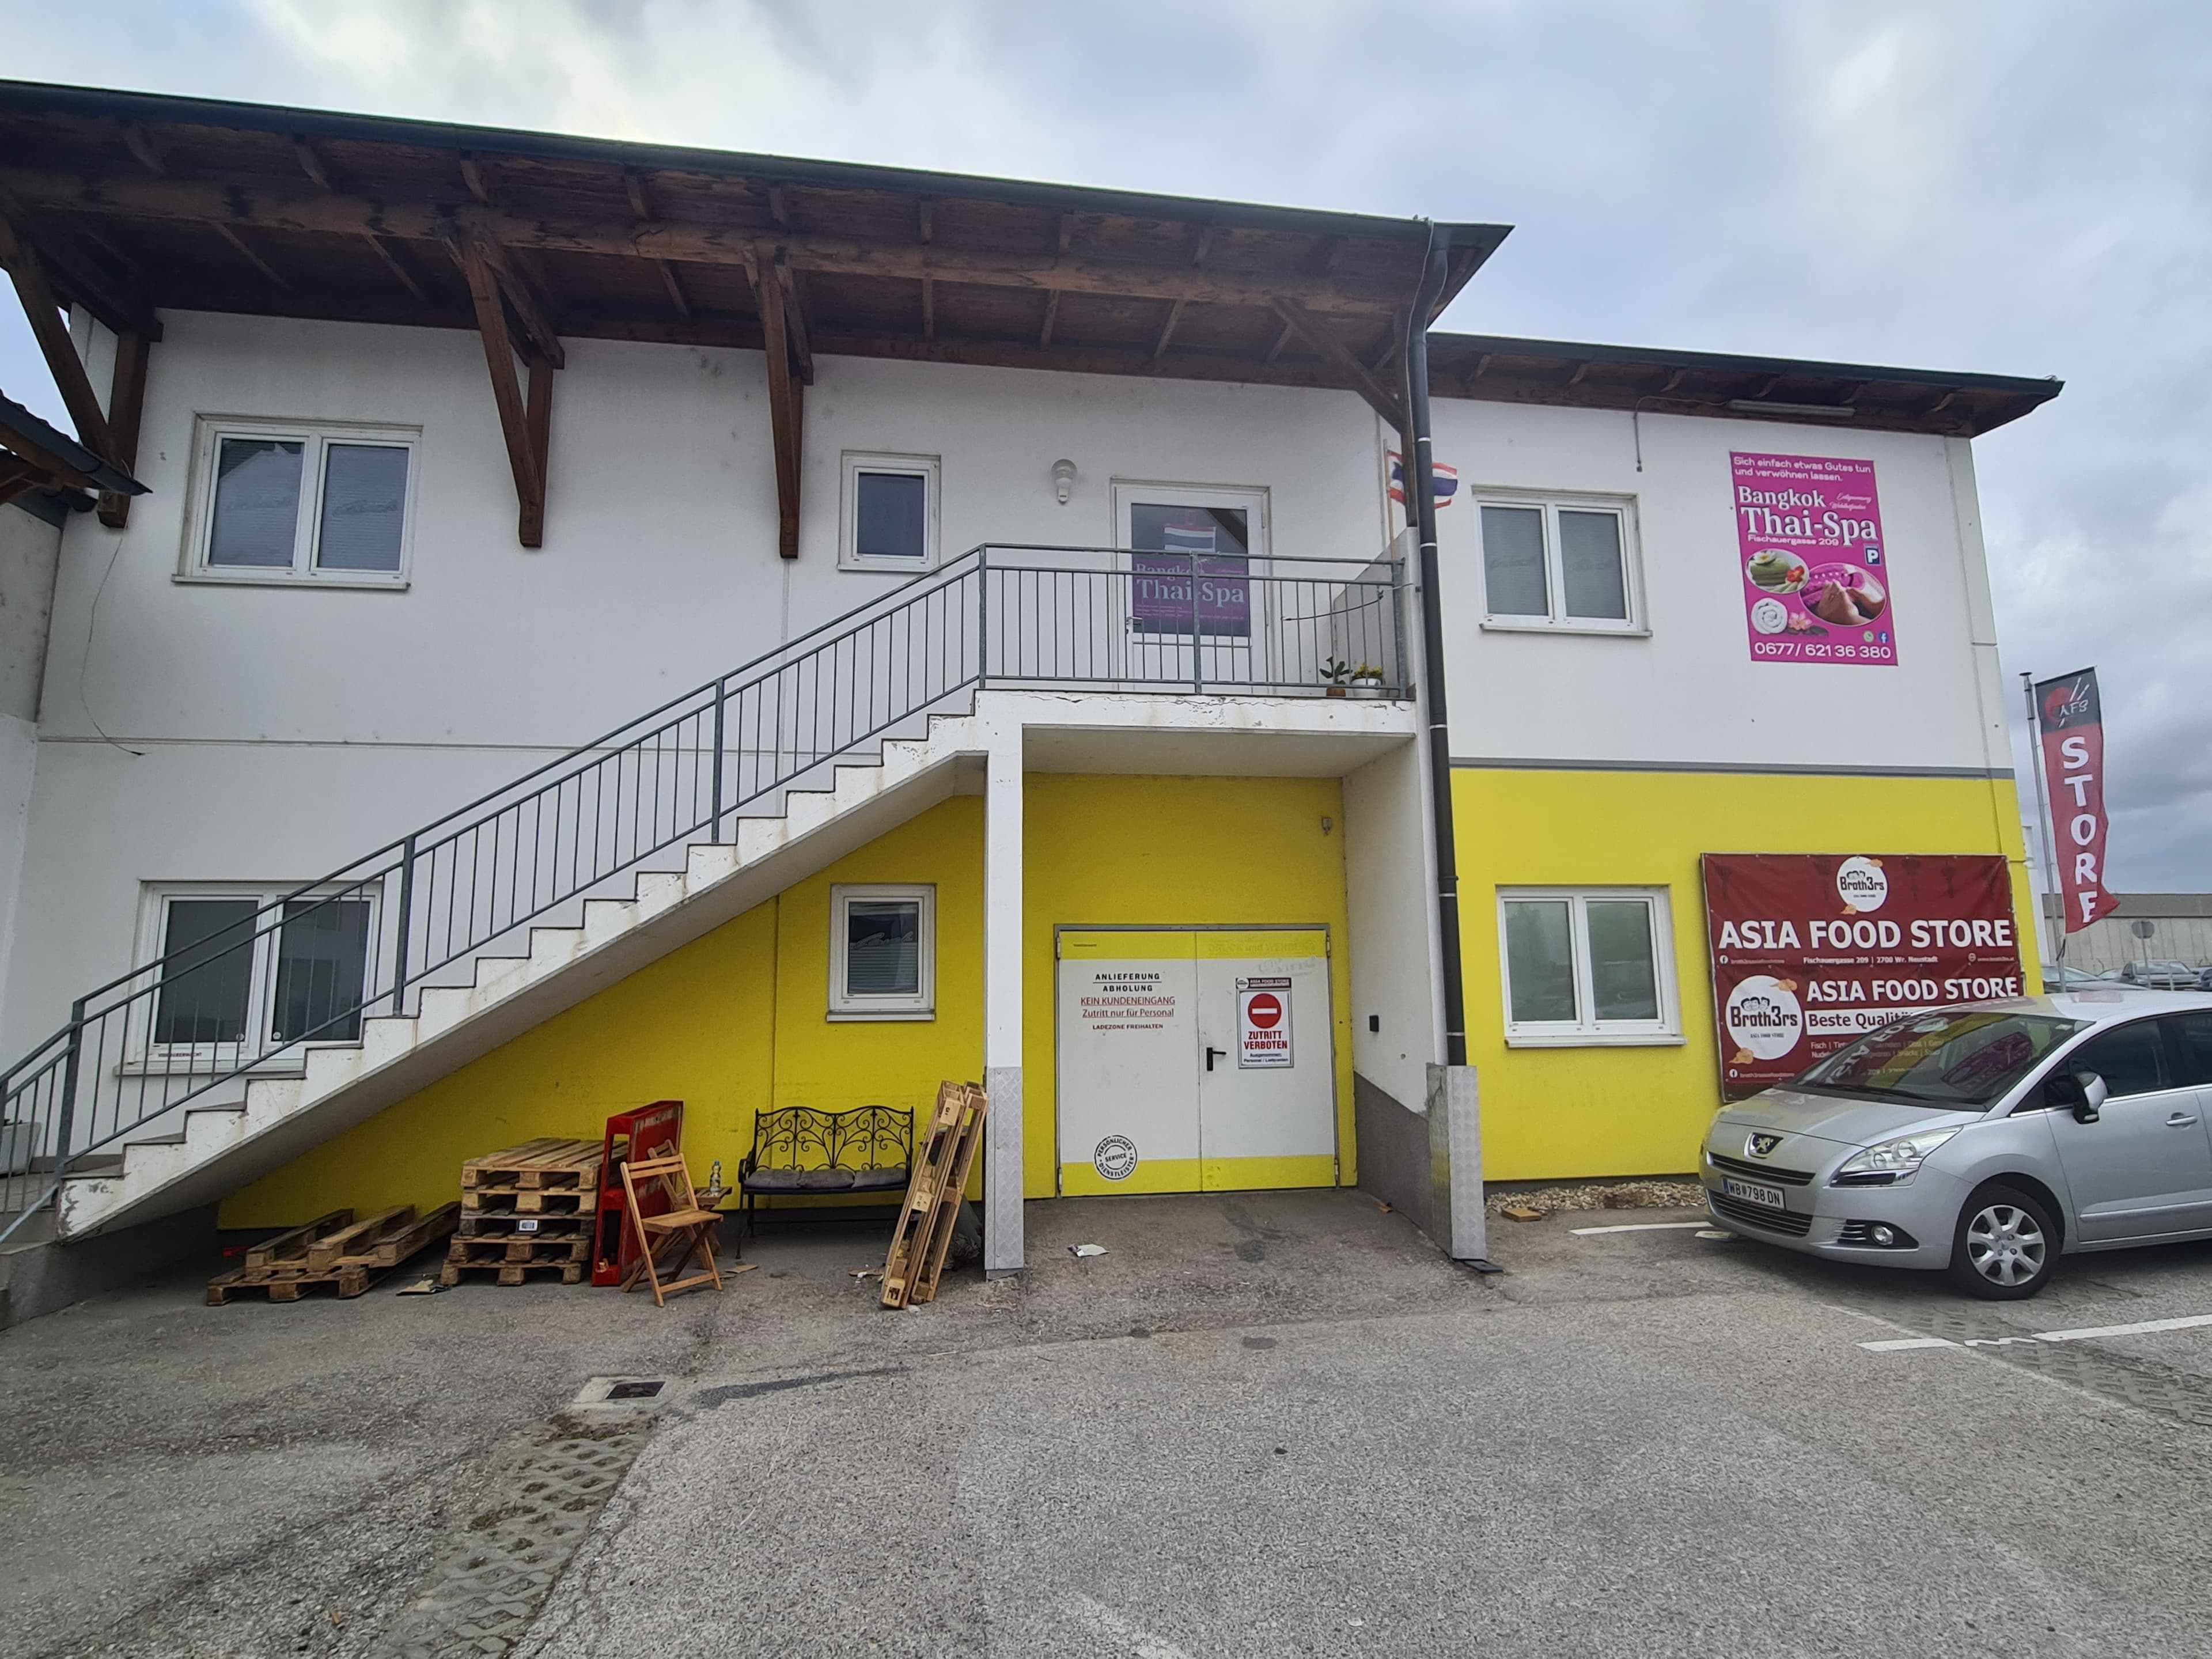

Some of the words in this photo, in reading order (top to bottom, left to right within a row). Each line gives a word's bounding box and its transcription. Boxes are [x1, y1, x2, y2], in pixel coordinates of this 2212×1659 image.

[1734, 456, 1755, 465] Sich
[1758, 458, 1791, 468] einfach
[1794, 461, 1823, 470] etwas
[1825, 462, 1853, 472] Gutes
[1855, 464, 1872, 474] tun
[1735, 468, 1753, 476] und
[1756, 468, 1809, 479] verwöhnen
[1810, 472, 1843, 482] lassen.
[1737, 486, 1826, 510] Bangkok
[1741, 506, 1878, 547] Thai-Spa
[1748, 535, 1816, 546] Fischauergasse
[1819, 538, 1839, 546] 209
[1859, 646, 1891, 658] 380
[2061, 736, 2098, 923] STORE
[1840, 876, 1885, 891] Broth3rs
[1718, 921, 1801, 949] ASIA
[1809, 920, 1901, 949] FOOD
[1910, 919, 2013, 948] STORE
[1803, 956, 1855, 965] Fischauergasse
[1806, 980, 1866, 1002] ASIA
[1872, 979, 1938, 1001] FOOD
[1945, 977, 2018, 1000] STORE
[1081, 997, 1100, 1005] KEIN
[1102, 996, 1176, 1005] KUNDENEINGANG
[1082, 1009, 1108, 1018] Zutritt
[1126, 1008, 1138, 1017] für
[1140, 1008, 1174, 1017] Personal
[1730, 1006, 1798, 1027] Broth3rs
[1809, 1014, 1851, 1027] Beste
[1248, 1030, 1282, 1040] ZUTRITT
[1244, 1040, 1288, 1050] VERBOTEN
[1810, 1041, 1827, 1050] Fisch
[1105, 1152, 1127, 1162] SERVICE
[1728, 1181, 1741, 1195] WB
[1747, 1185, 1766, 1202] 798
[1767, 1190, 1781, 1206] DN
